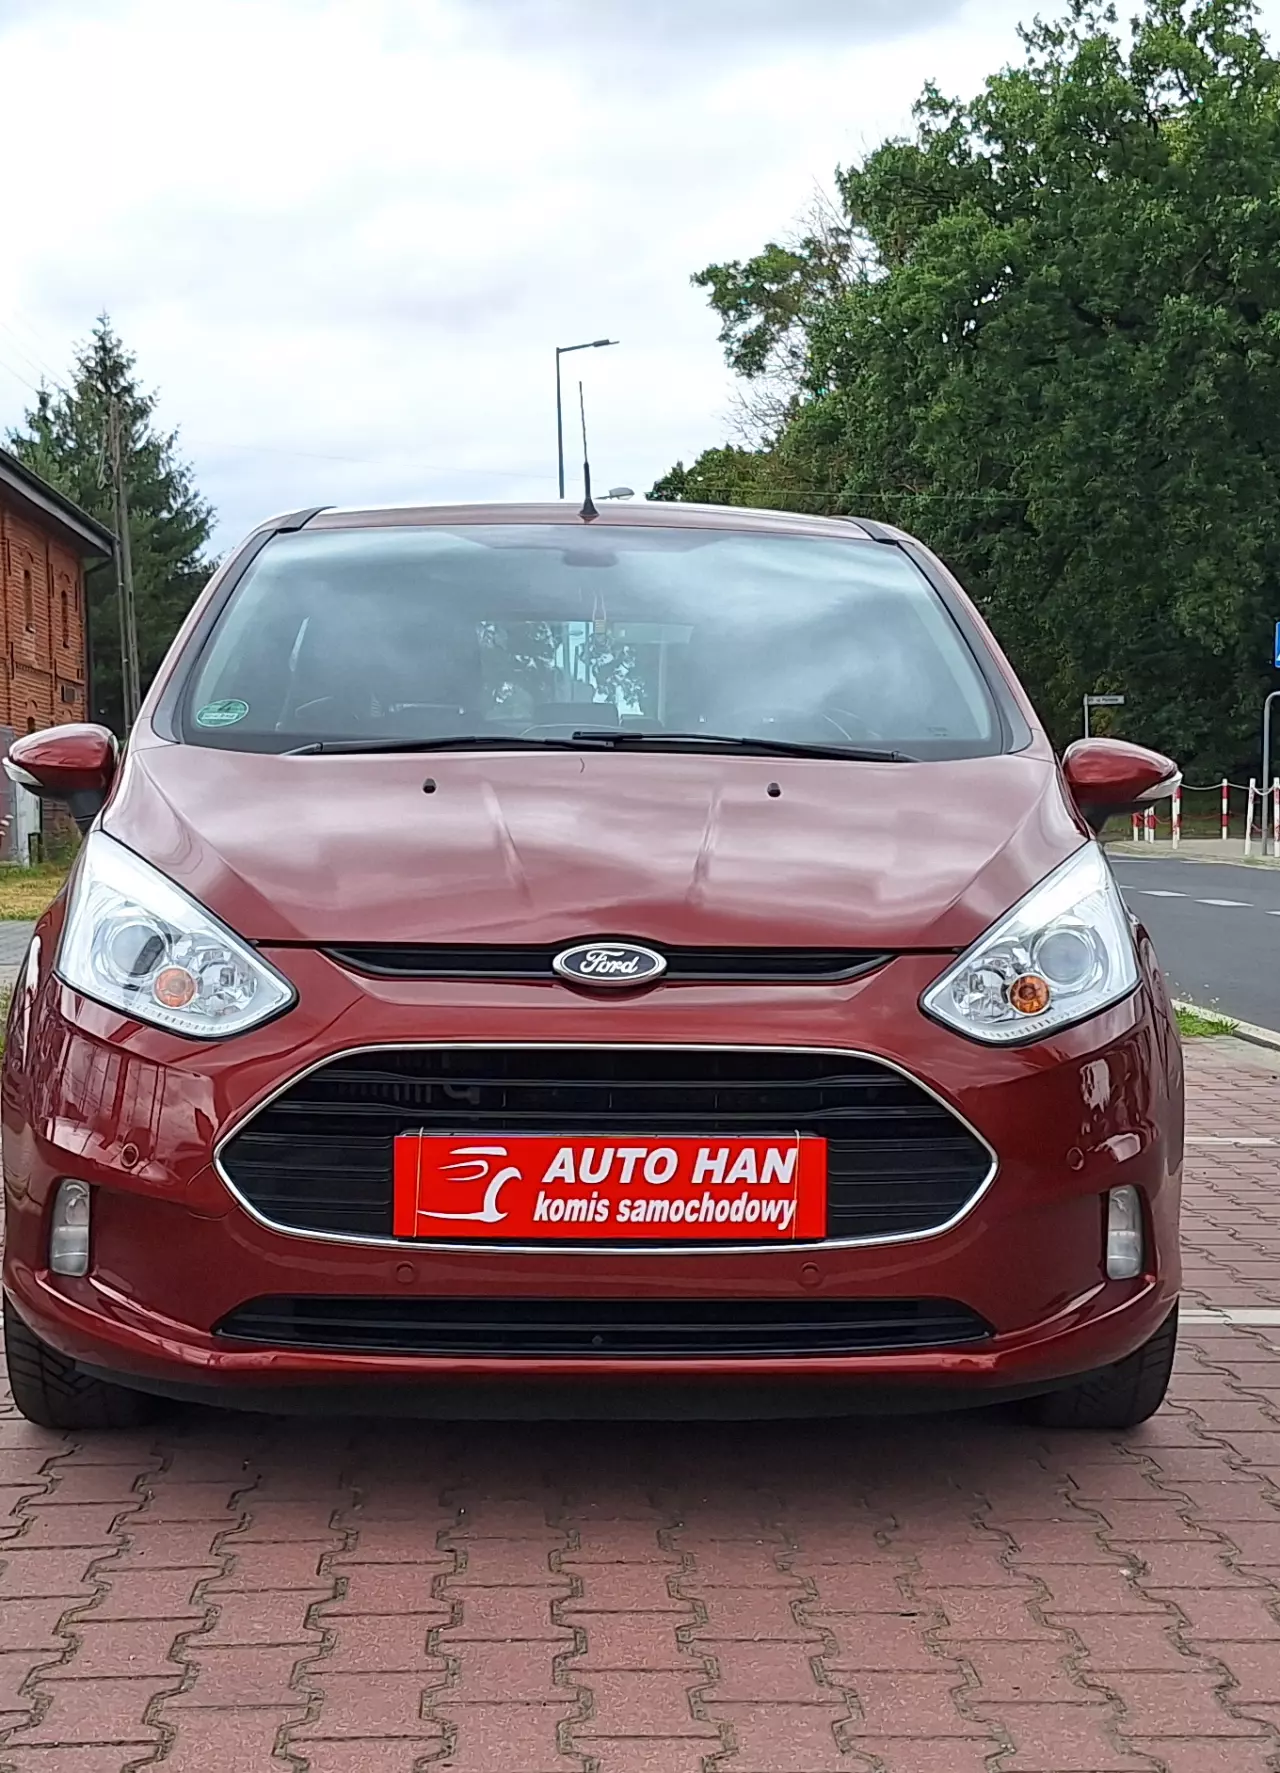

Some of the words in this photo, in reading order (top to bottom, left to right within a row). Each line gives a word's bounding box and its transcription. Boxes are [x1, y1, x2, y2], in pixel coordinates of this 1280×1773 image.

[580, 950, 640, 973] Ford
[542, 1147, 679, 1184] AUTO
[691, 1147, 798, 1184] HAN
[533, 1191, 610, 1223] komis
[615, 1192, 798, 1231] samochodowy
